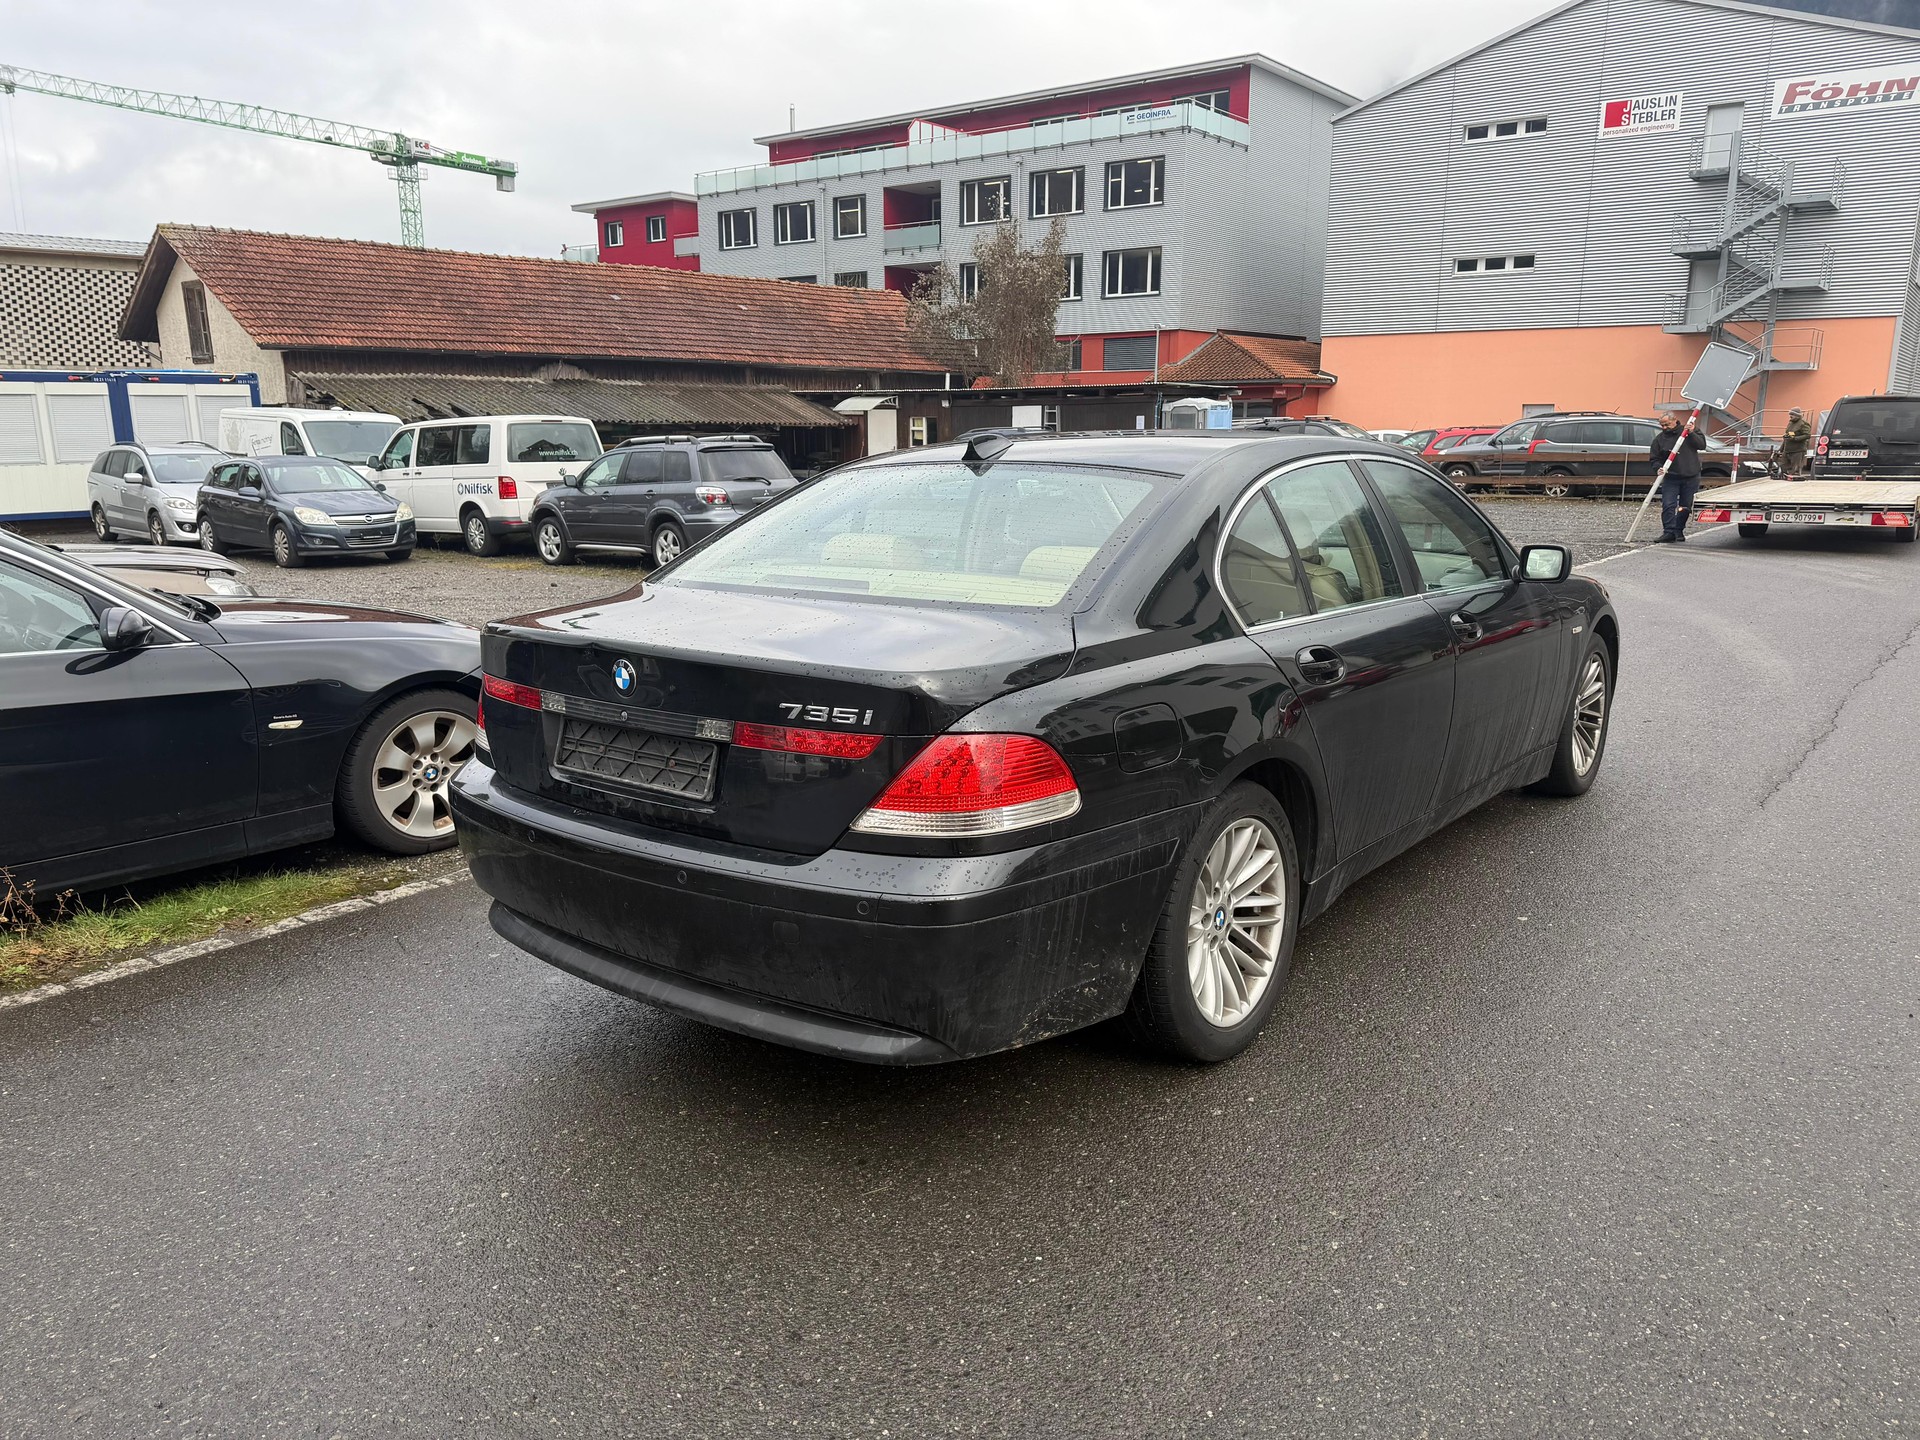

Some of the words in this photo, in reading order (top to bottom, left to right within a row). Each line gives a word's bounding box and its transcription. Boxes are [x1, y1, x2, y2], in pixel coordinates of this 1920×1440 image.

[1782, 77, 1920, 105] FÖHN
[1623, 95, 1678, 113] JAUSLIN
[1781, 92, 1912, 114] TRANSPORTE
[1136, 109, 1171, 120] GEOINFRA
[1621, 109, 1676, 126] STEBLER
[1602, 127, 1639, 137] personalized
[1640, 123, 1675, 133] engineering
[464, 483, 493, 495] Nilfisk
